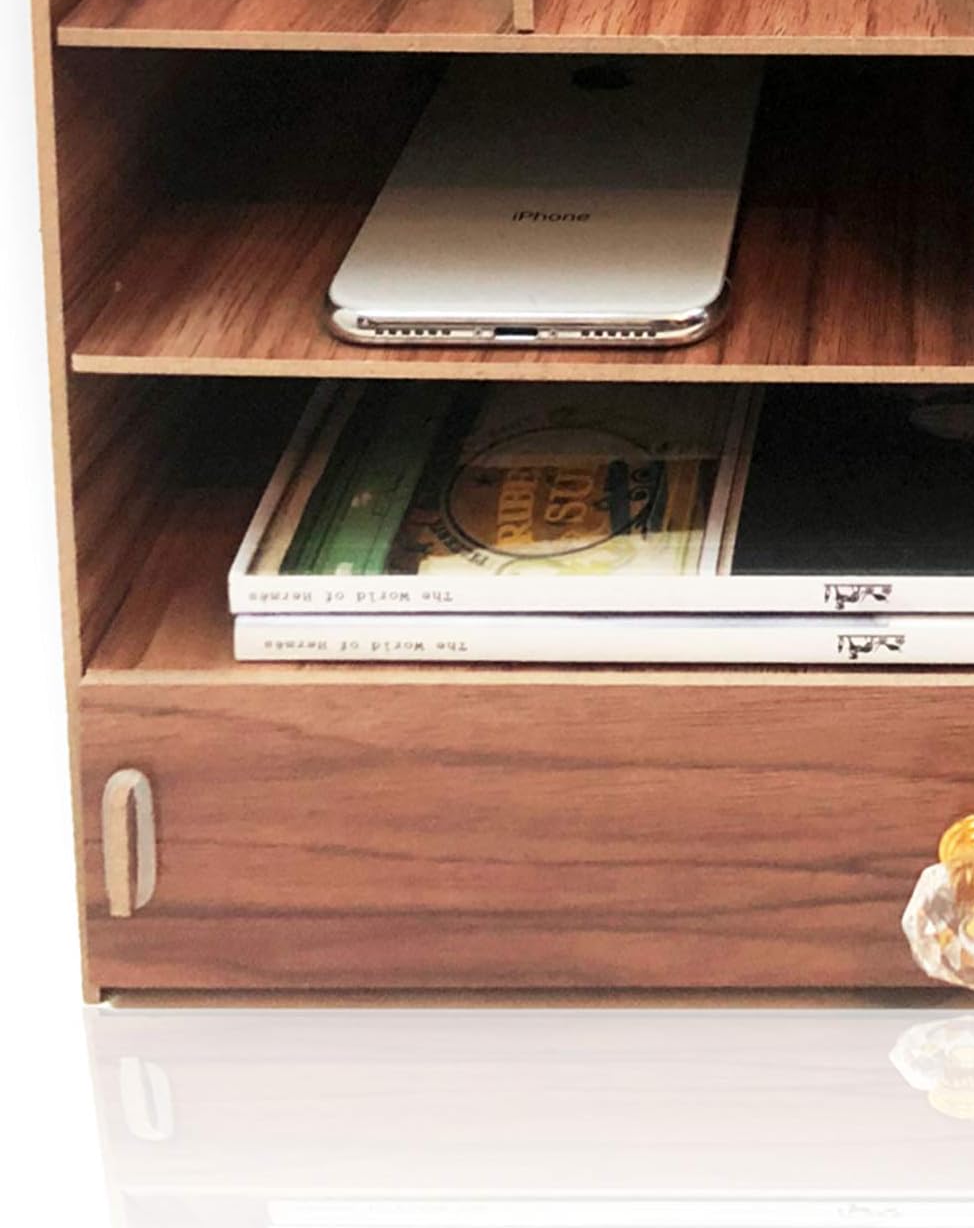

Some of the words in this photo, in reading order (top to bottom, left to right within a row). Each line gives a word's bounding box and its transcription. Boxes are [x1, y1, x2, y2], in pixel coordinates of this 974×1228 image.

[512, 210, 591, 222] iPhone
[325, 590, 345, 603] of
[356, 590, 411, 603] World
[421, 590, 453, 603] The
[340, 640, 359, 653] of
[371, 640, 425, 653] World
[435, 640, 467, 653] The
